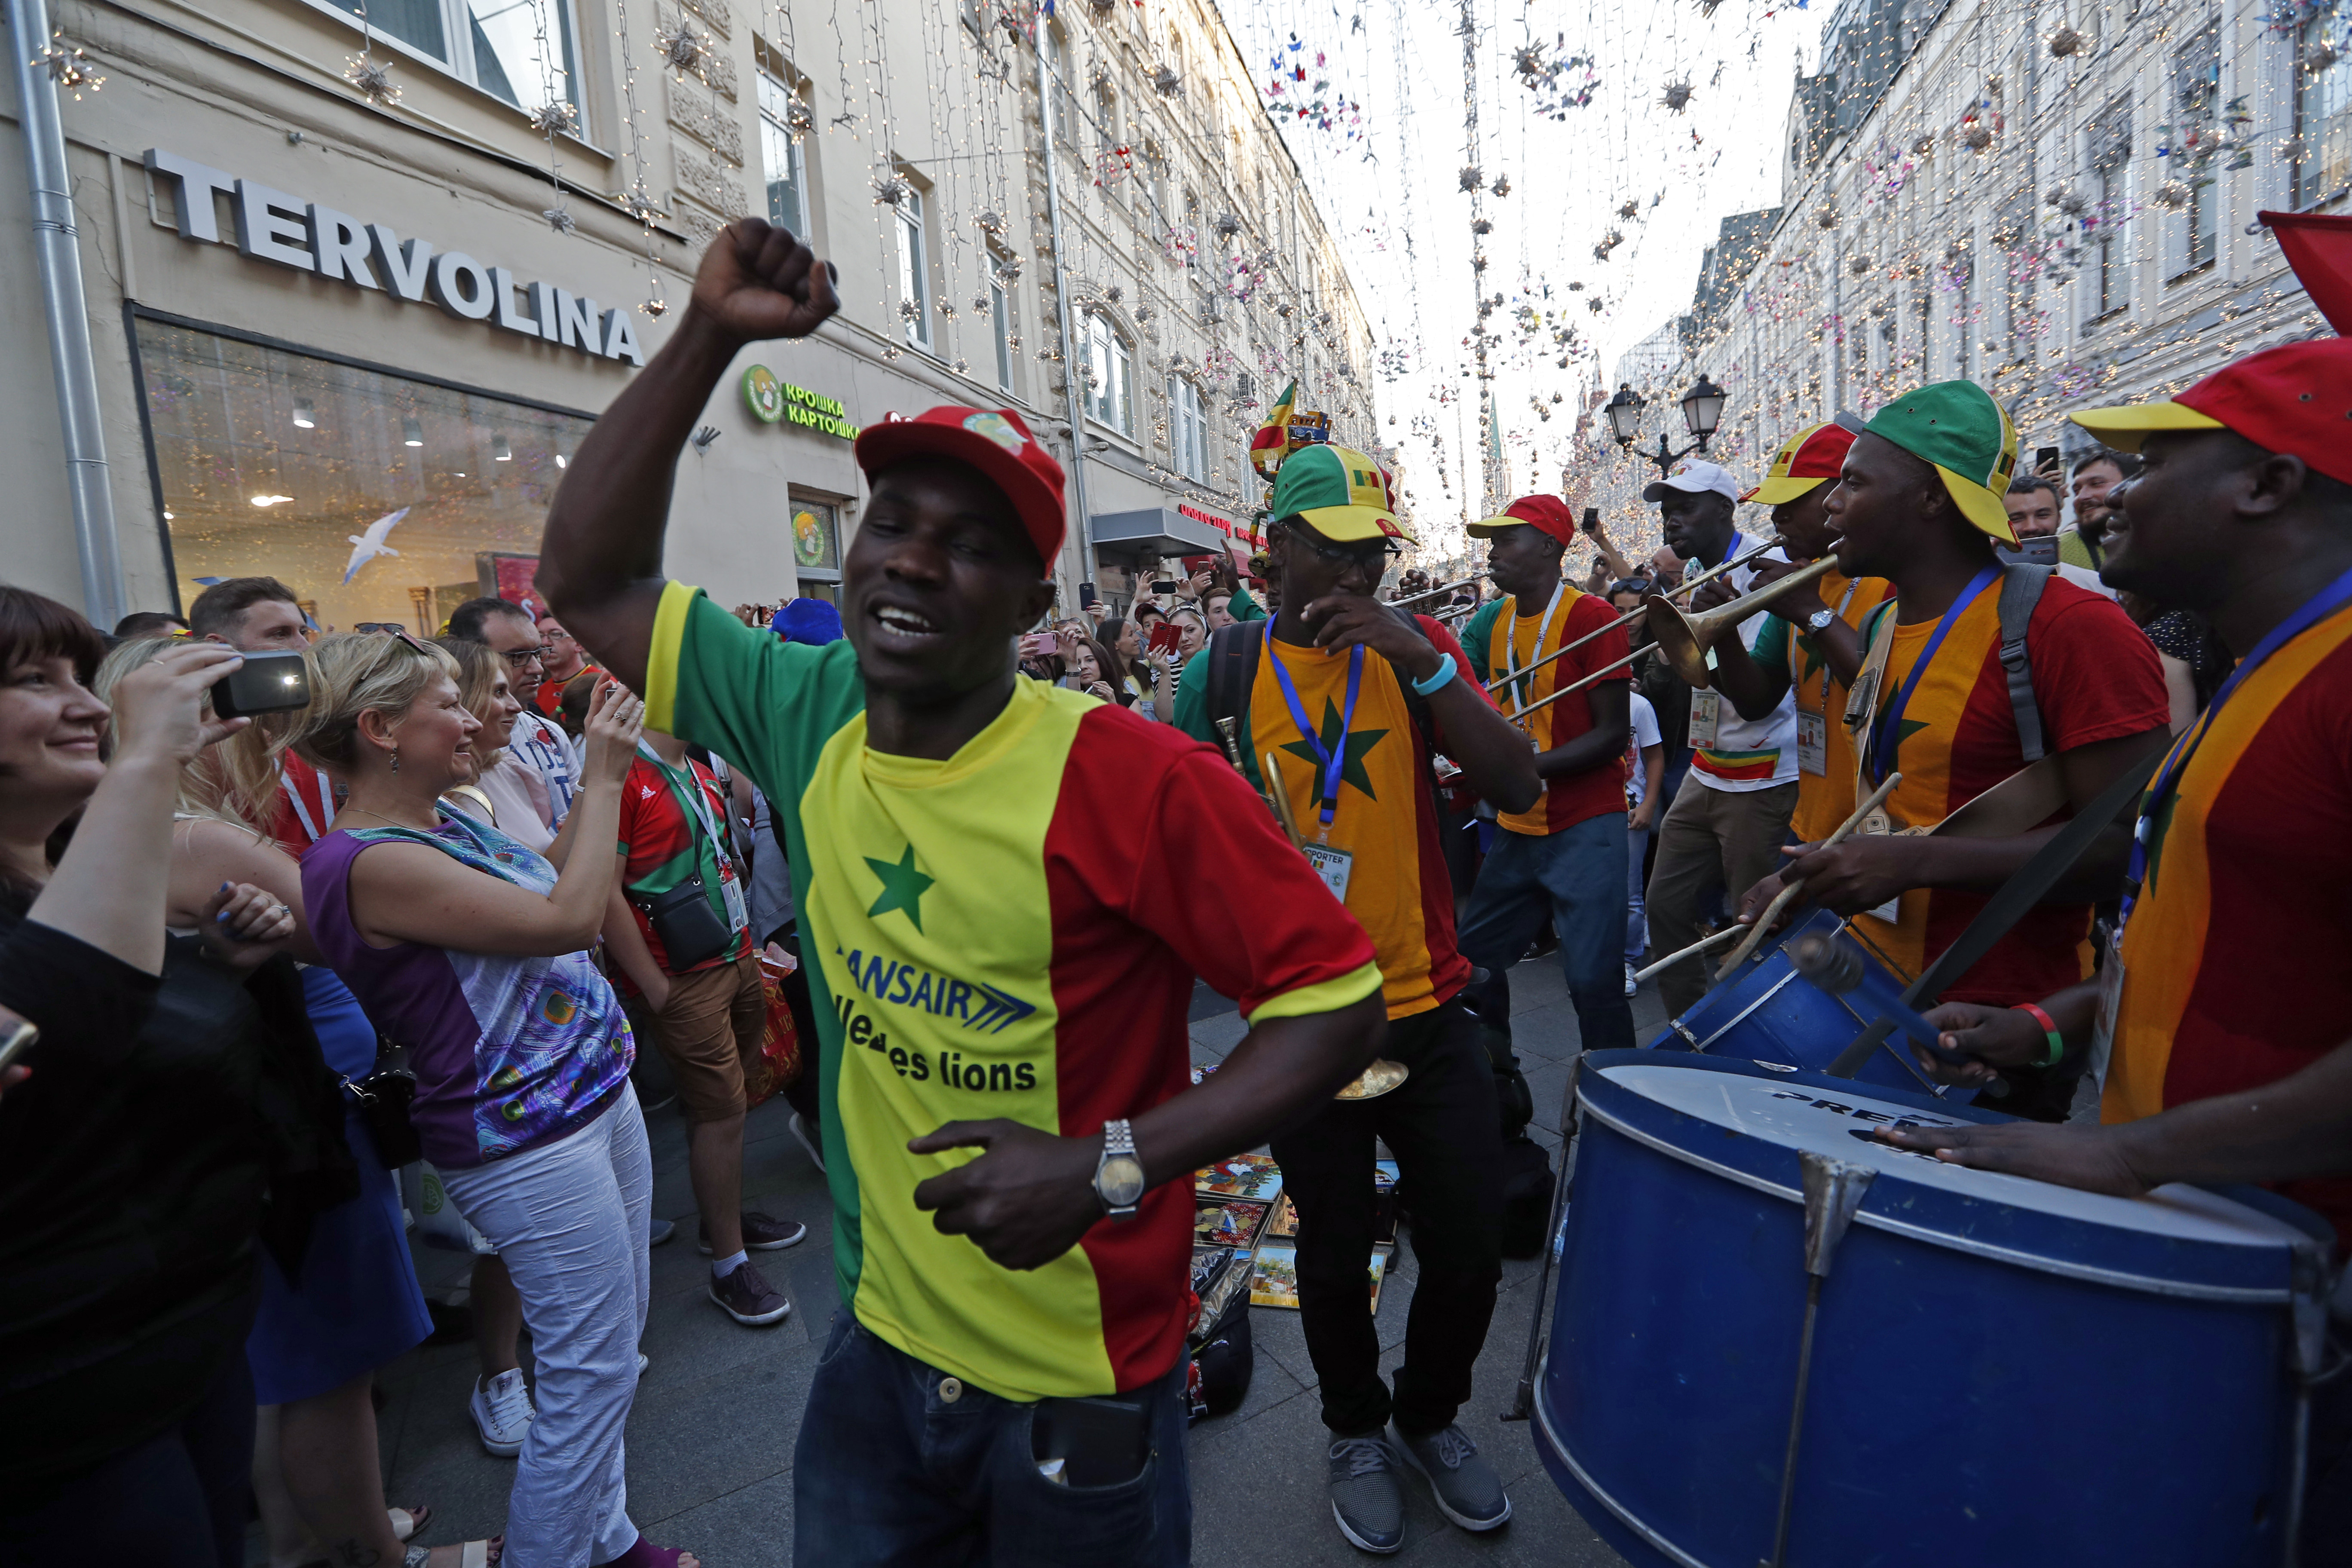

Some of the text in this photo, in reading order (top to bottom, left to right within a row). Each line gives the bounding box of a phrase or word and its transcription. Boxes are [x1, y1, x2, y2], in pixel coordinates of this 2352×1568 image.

[144, 148, 645, 368] TERVOLINA
[782, 382, 845, 418] КРОШКА
[940, 1052, 1036, 1092] lions
